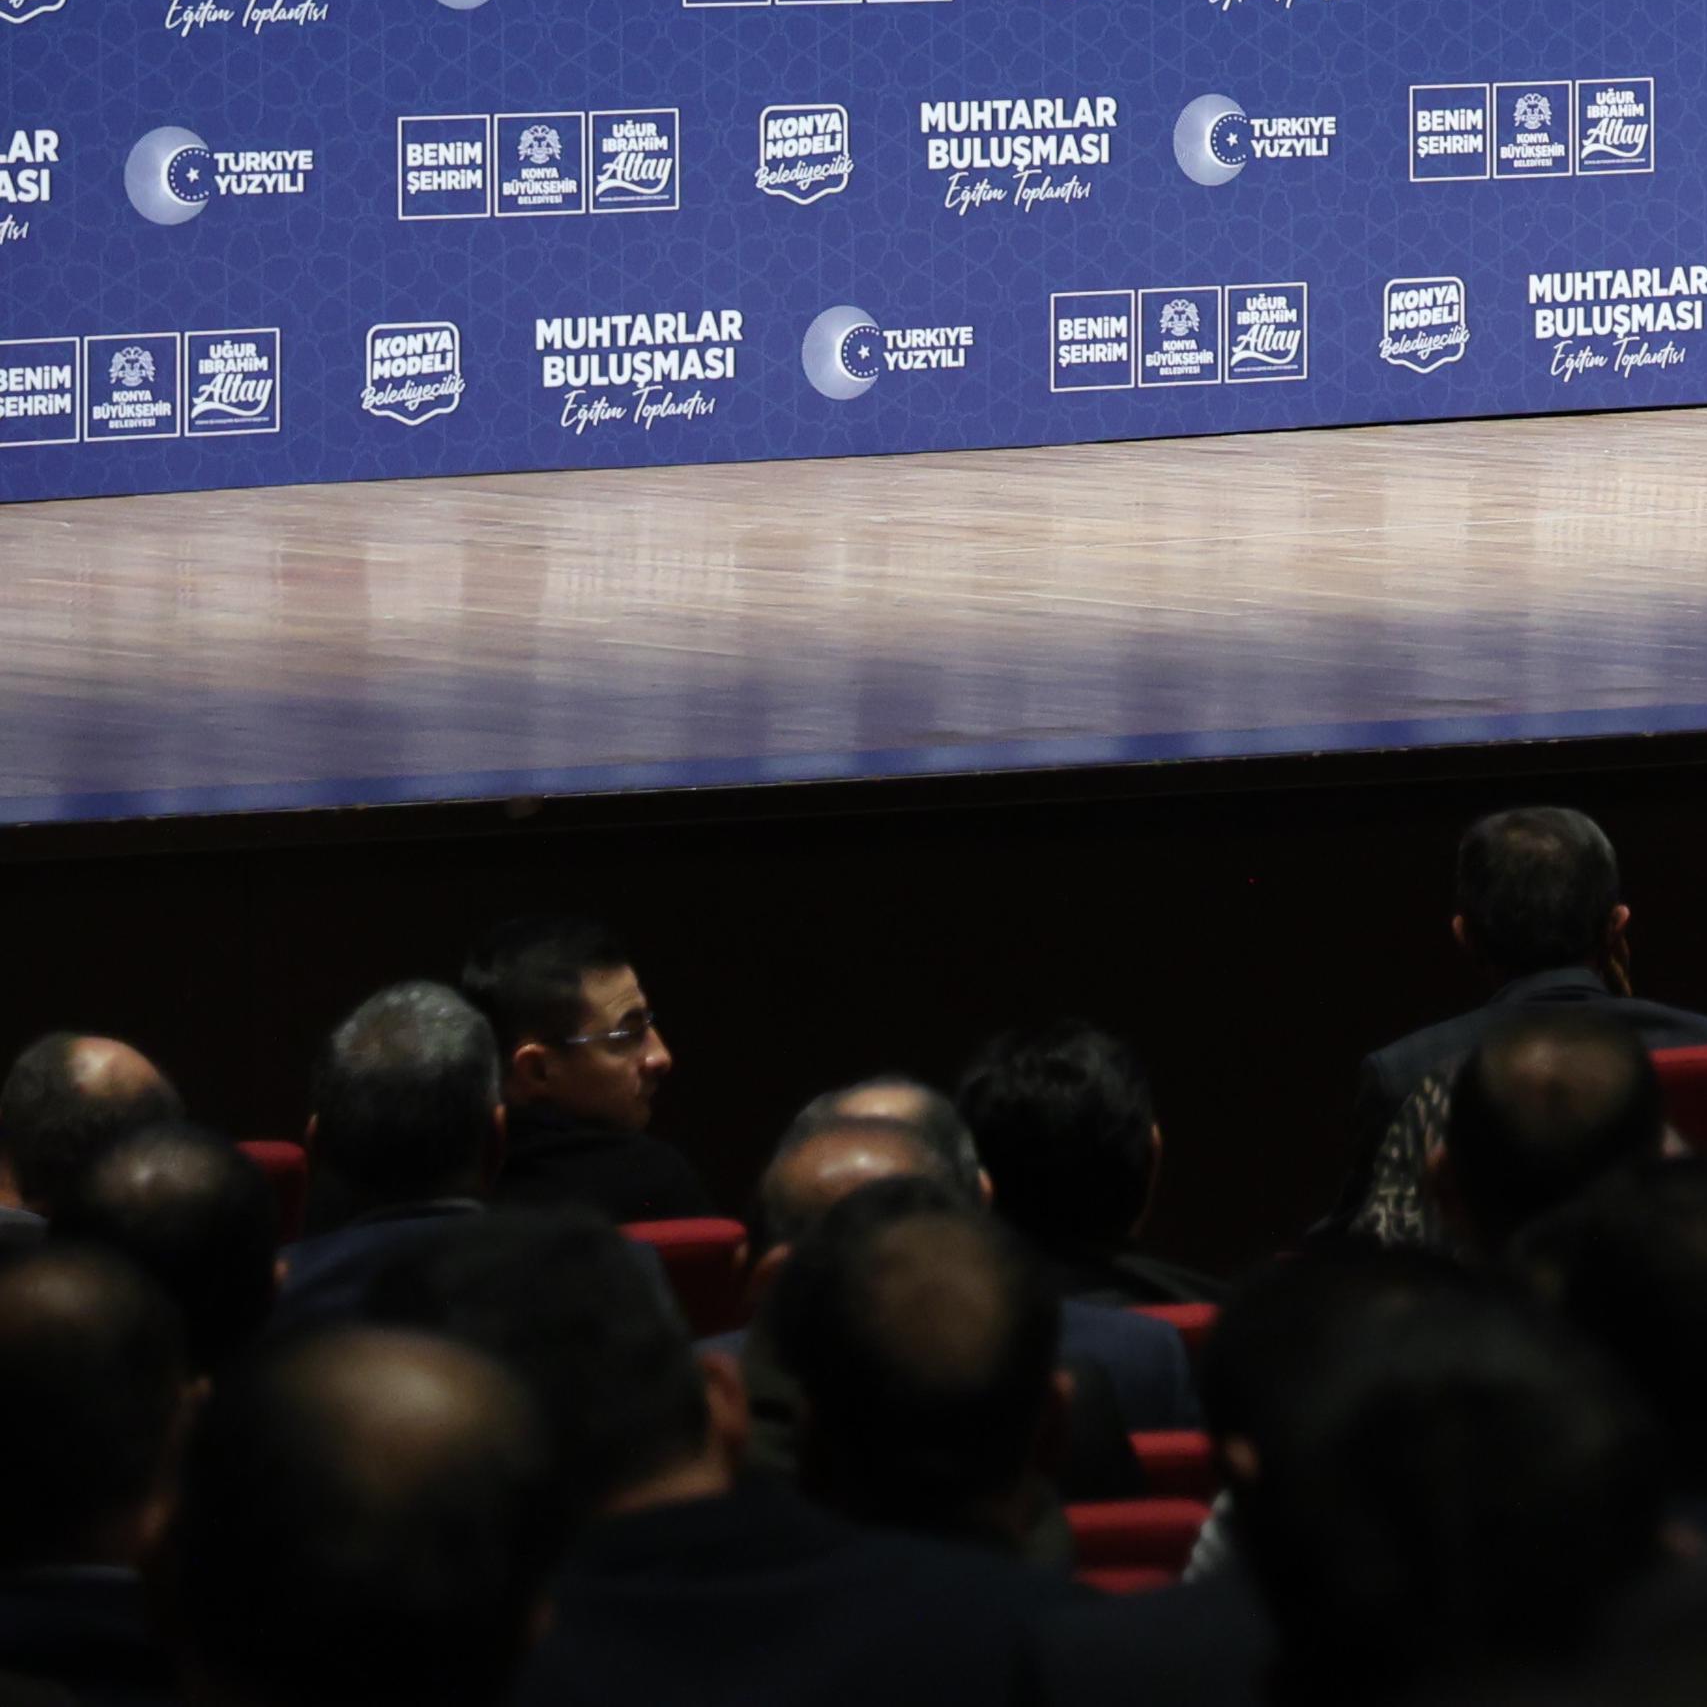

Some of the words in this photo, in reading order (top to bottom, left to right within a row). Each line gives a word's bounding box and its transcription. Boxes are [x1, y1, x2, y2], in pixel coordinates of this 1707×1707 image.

[613, 120, 657, 138] UĞUR
[767, 112, 842, 140] KONYA
[921, 97, 1116, 132] MUHTARLAR
[407, 142, 482, 166] BENİM
[603, 136, 668, 152] İBRAHİM
[766, 133, 842, 159] MODELİ
[928, 134, 1108, 172] BULUŞMASI
[407, 169, 482, 194] ŞEHRİM
[521, 168, 559, 179] KONYA
[596, 151, 672, 196] Altay
[755, 153, 853, 190] Belediyecilik
[945, 172, 1007, 215] Eğitim
[1391, 285, 1459, 311] KONYA
[536, 310, 742, 350] MUHTARLAR
[1390, 305, 1459, 330] MODELİ
[1536, 301, 1702, 339] BULUŞMASI
[1379, 323, 1469, 360] Belediyecilik
[544, 347, 734, 389] BULUŞMASI
[1551, 340, 1607, 382] Eğitim
[561, 390, 626, 434] Eğitim
